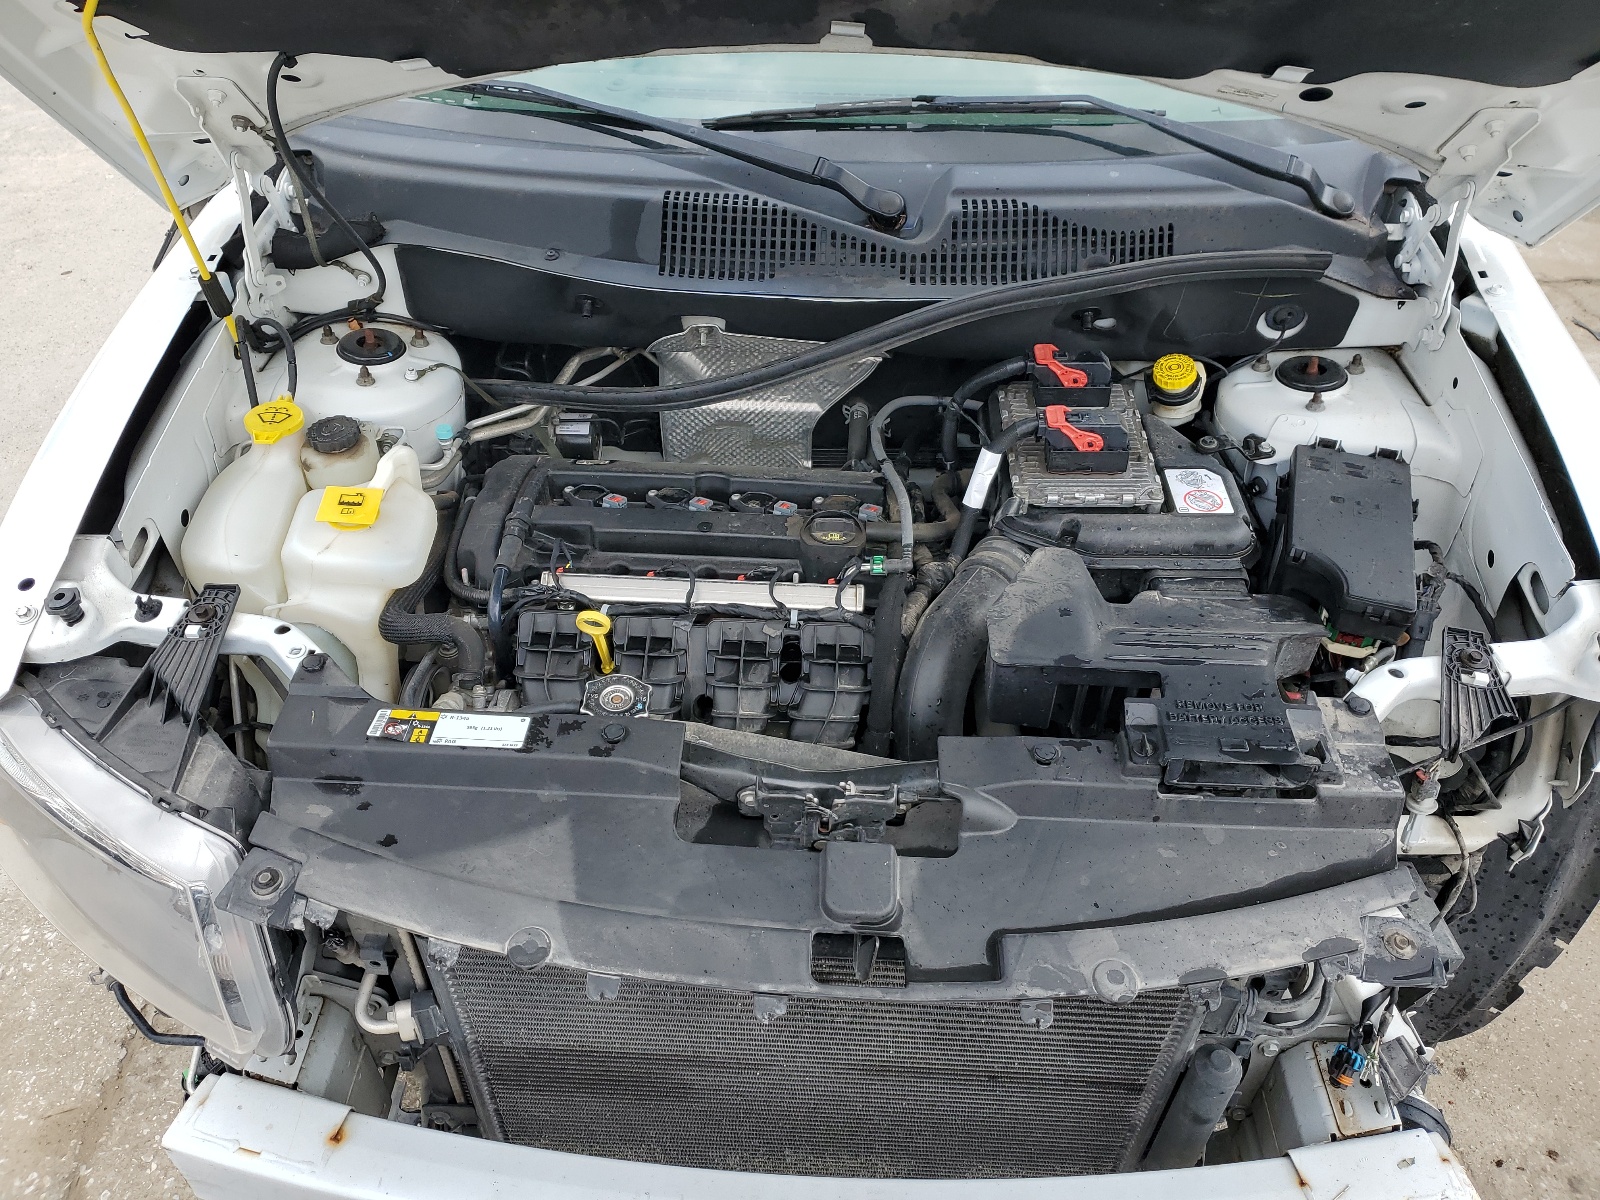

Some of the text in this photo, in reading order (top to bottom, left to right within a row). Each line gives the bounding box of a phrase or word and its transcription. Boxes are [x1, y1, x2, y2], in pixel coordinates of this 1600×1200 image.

[1176, 699, 1265, 714] REMOVE FOR
[1167, 711, 1286, 726] BATTERY ACCESS
